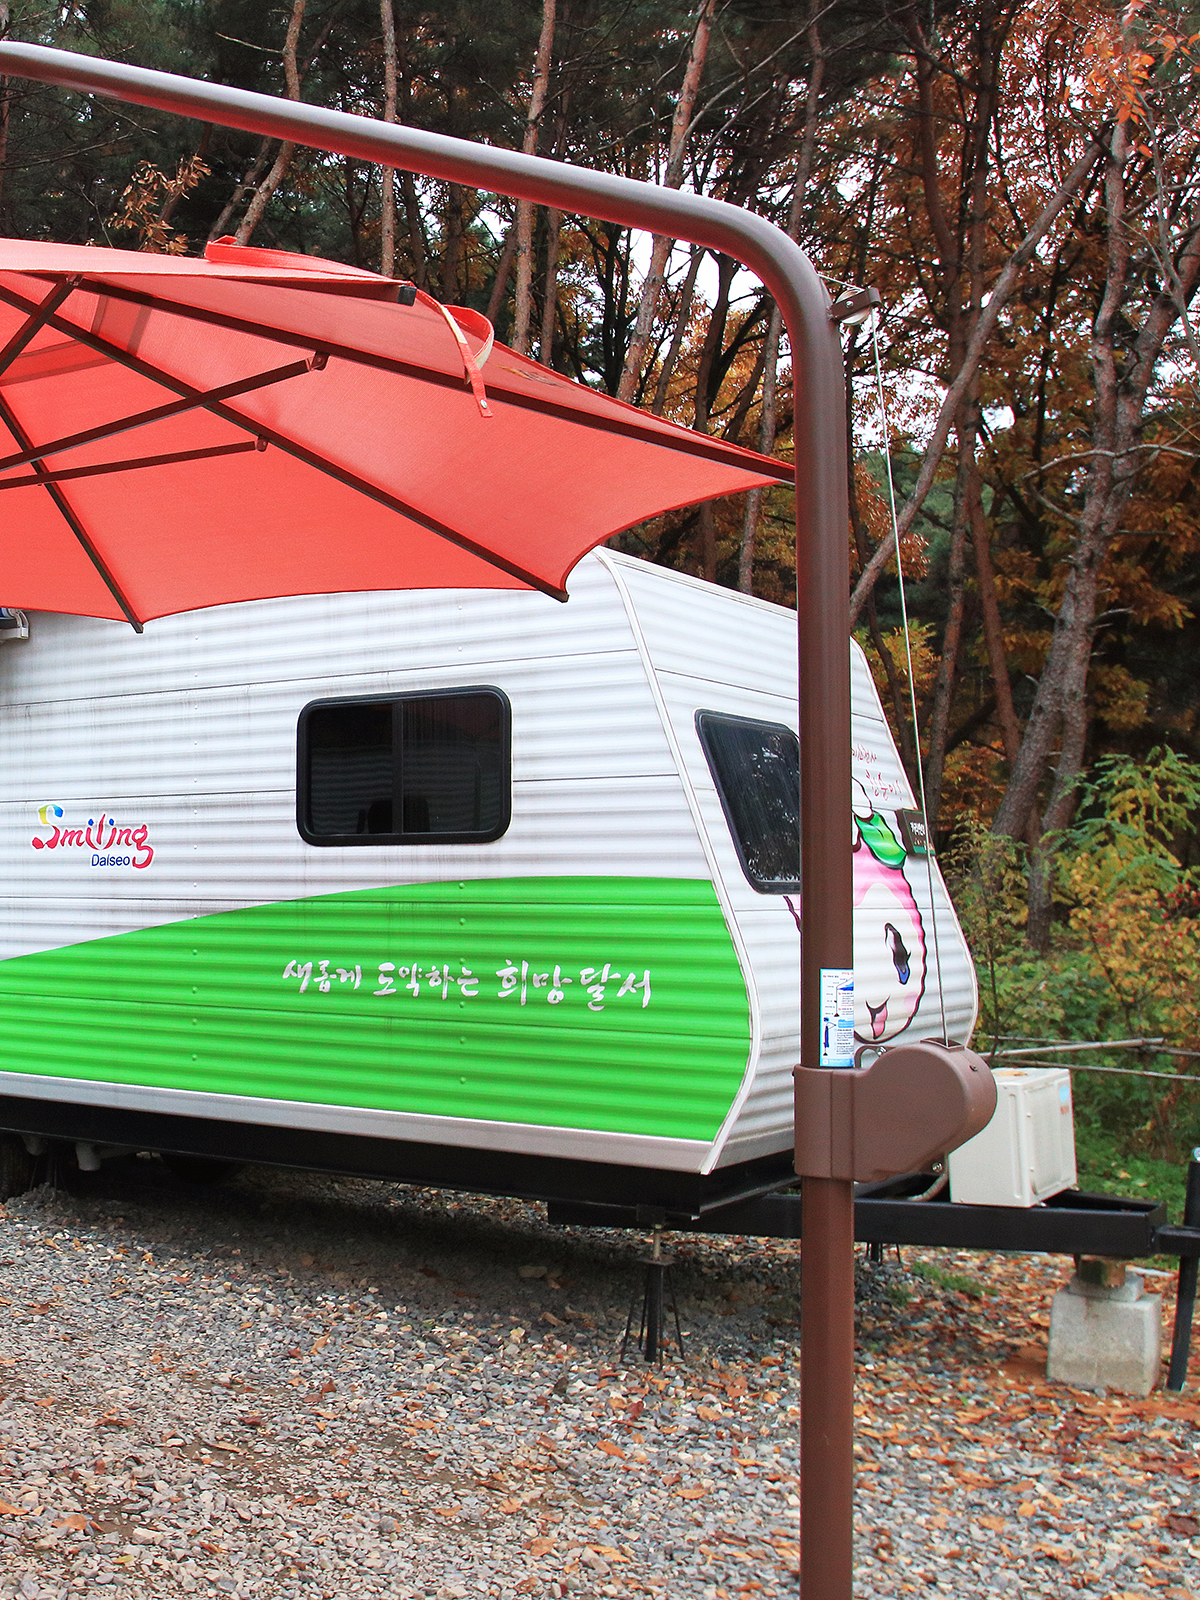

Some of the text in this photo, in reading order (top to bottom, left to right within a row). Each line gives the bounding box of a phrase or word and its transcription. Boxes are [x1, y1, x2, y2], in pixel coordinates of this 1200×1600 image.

[31, 803, 154, 869] Smiling
[91, 854, 131, 867] Dalseo
[282, 959, 363, 994] 새롭게
[373, 961, 480, 1000] 도약하는
